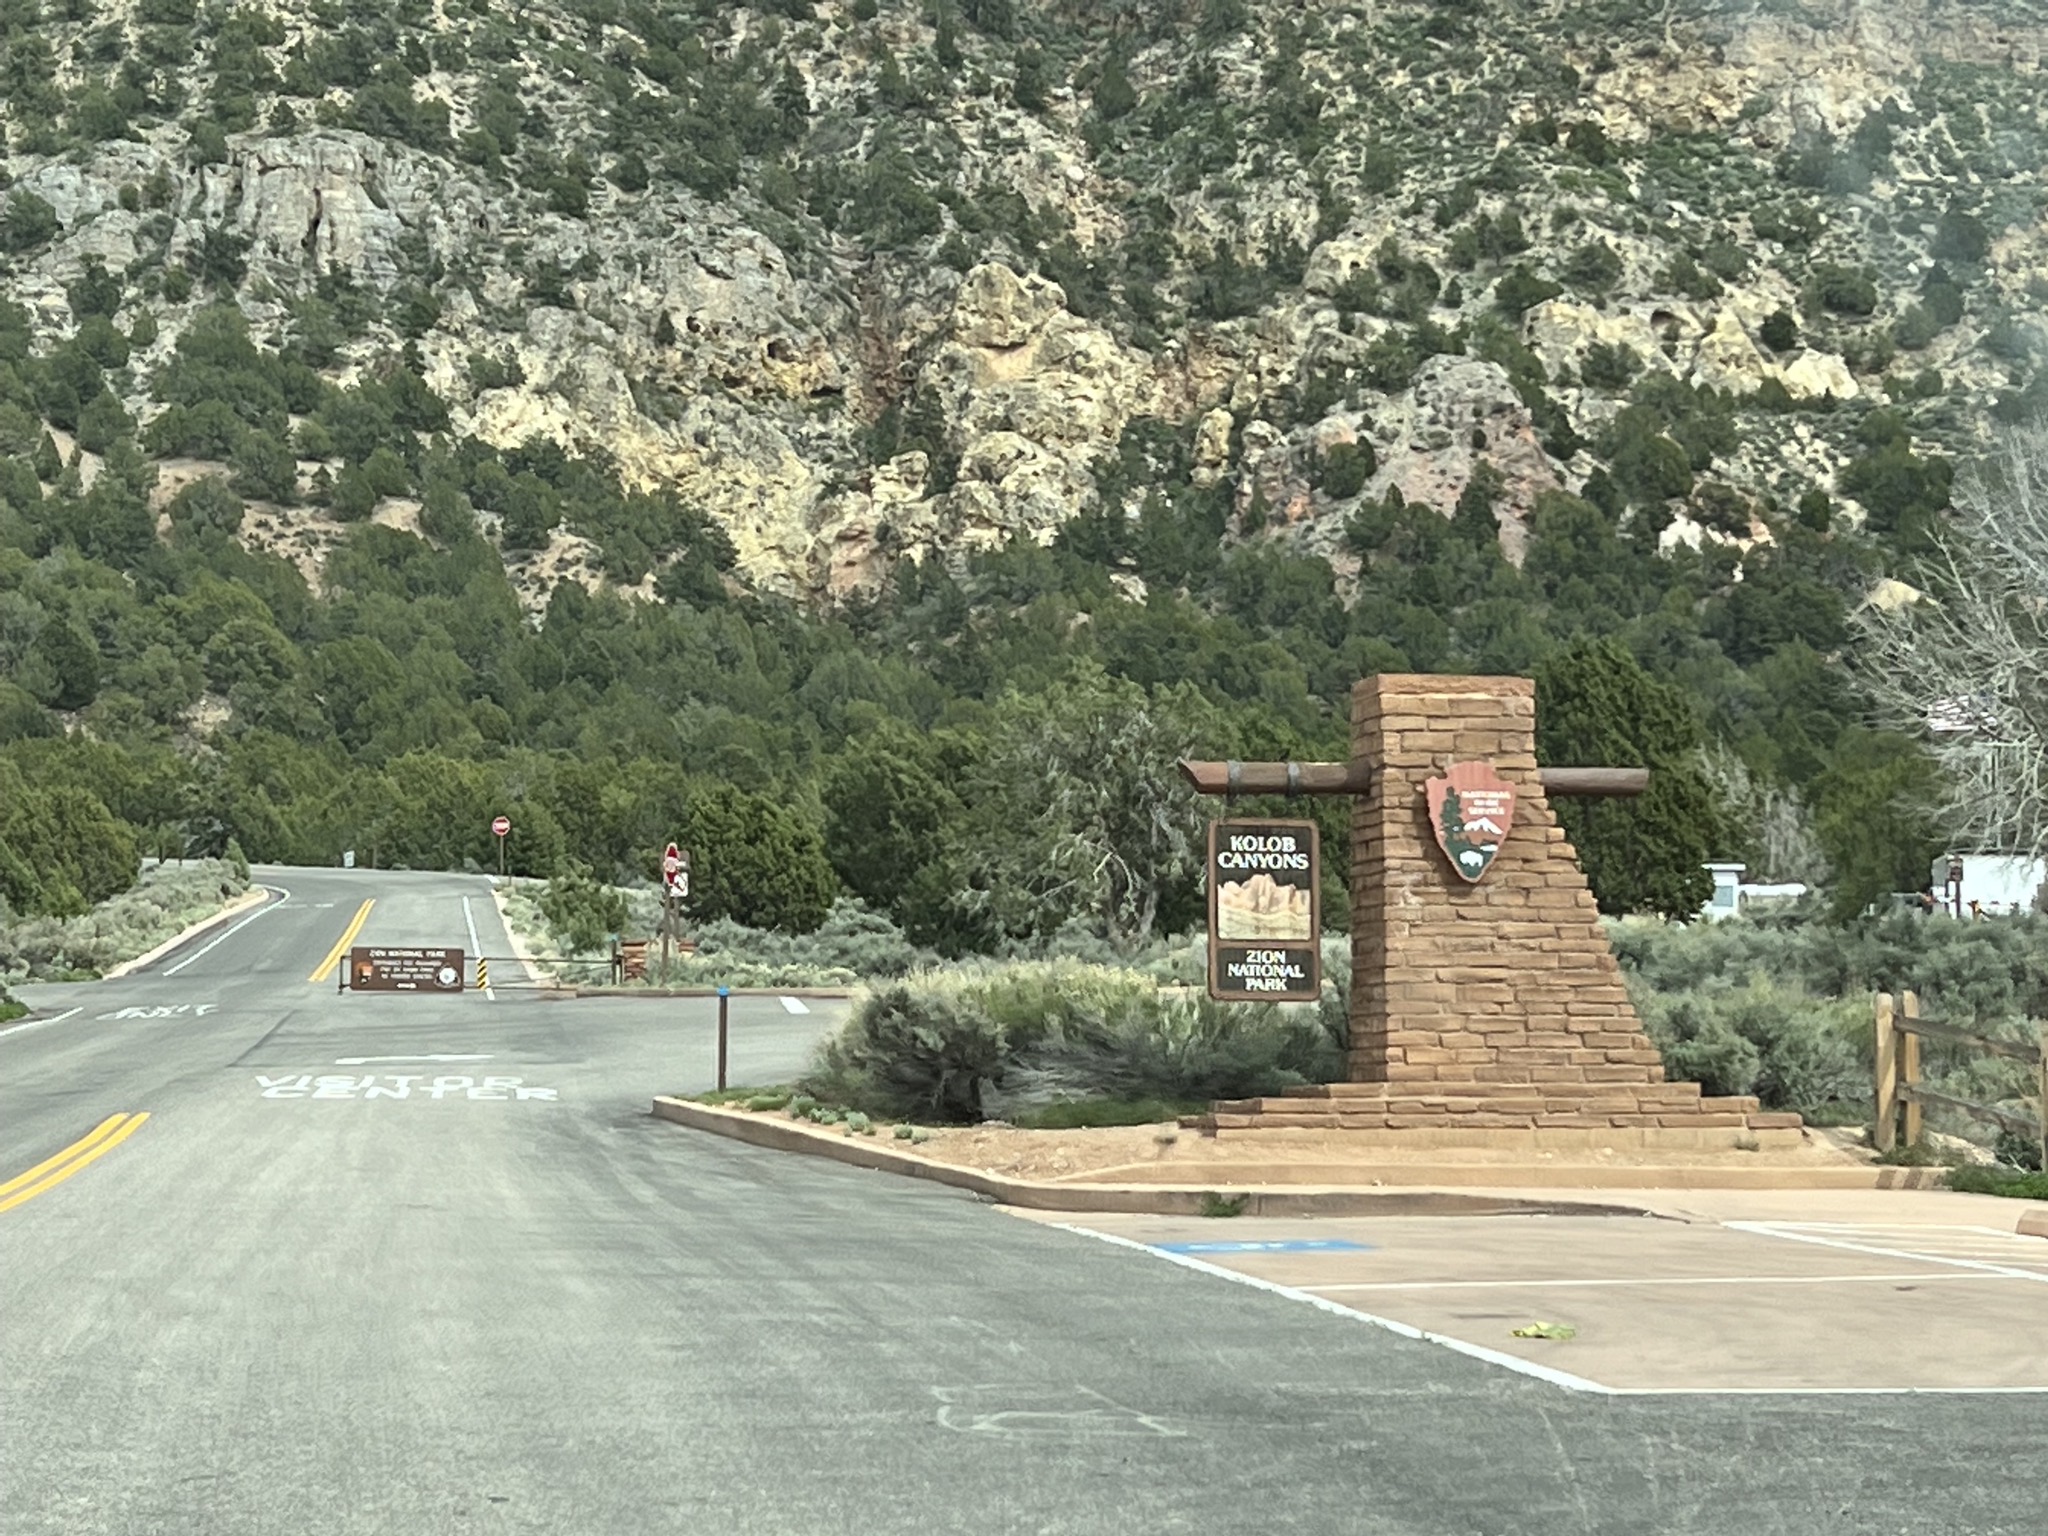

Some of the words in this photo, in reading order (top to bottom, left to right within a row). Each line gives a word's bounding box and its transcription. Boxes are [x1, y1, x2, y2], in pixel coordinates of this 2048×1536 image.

[1229, 835, 1296, 852] KOLOB
[1217, 852, 1310, 869] CANYONS
[1246, 950, 1286, 963] ZION
[1228, 963, 1305, 978] NATIONAL
[1245, 977, 1287, 991] PARK
[255, 1075, 524, 1091] VISITOR
[260, 1086, 558, 1102] CENTER
